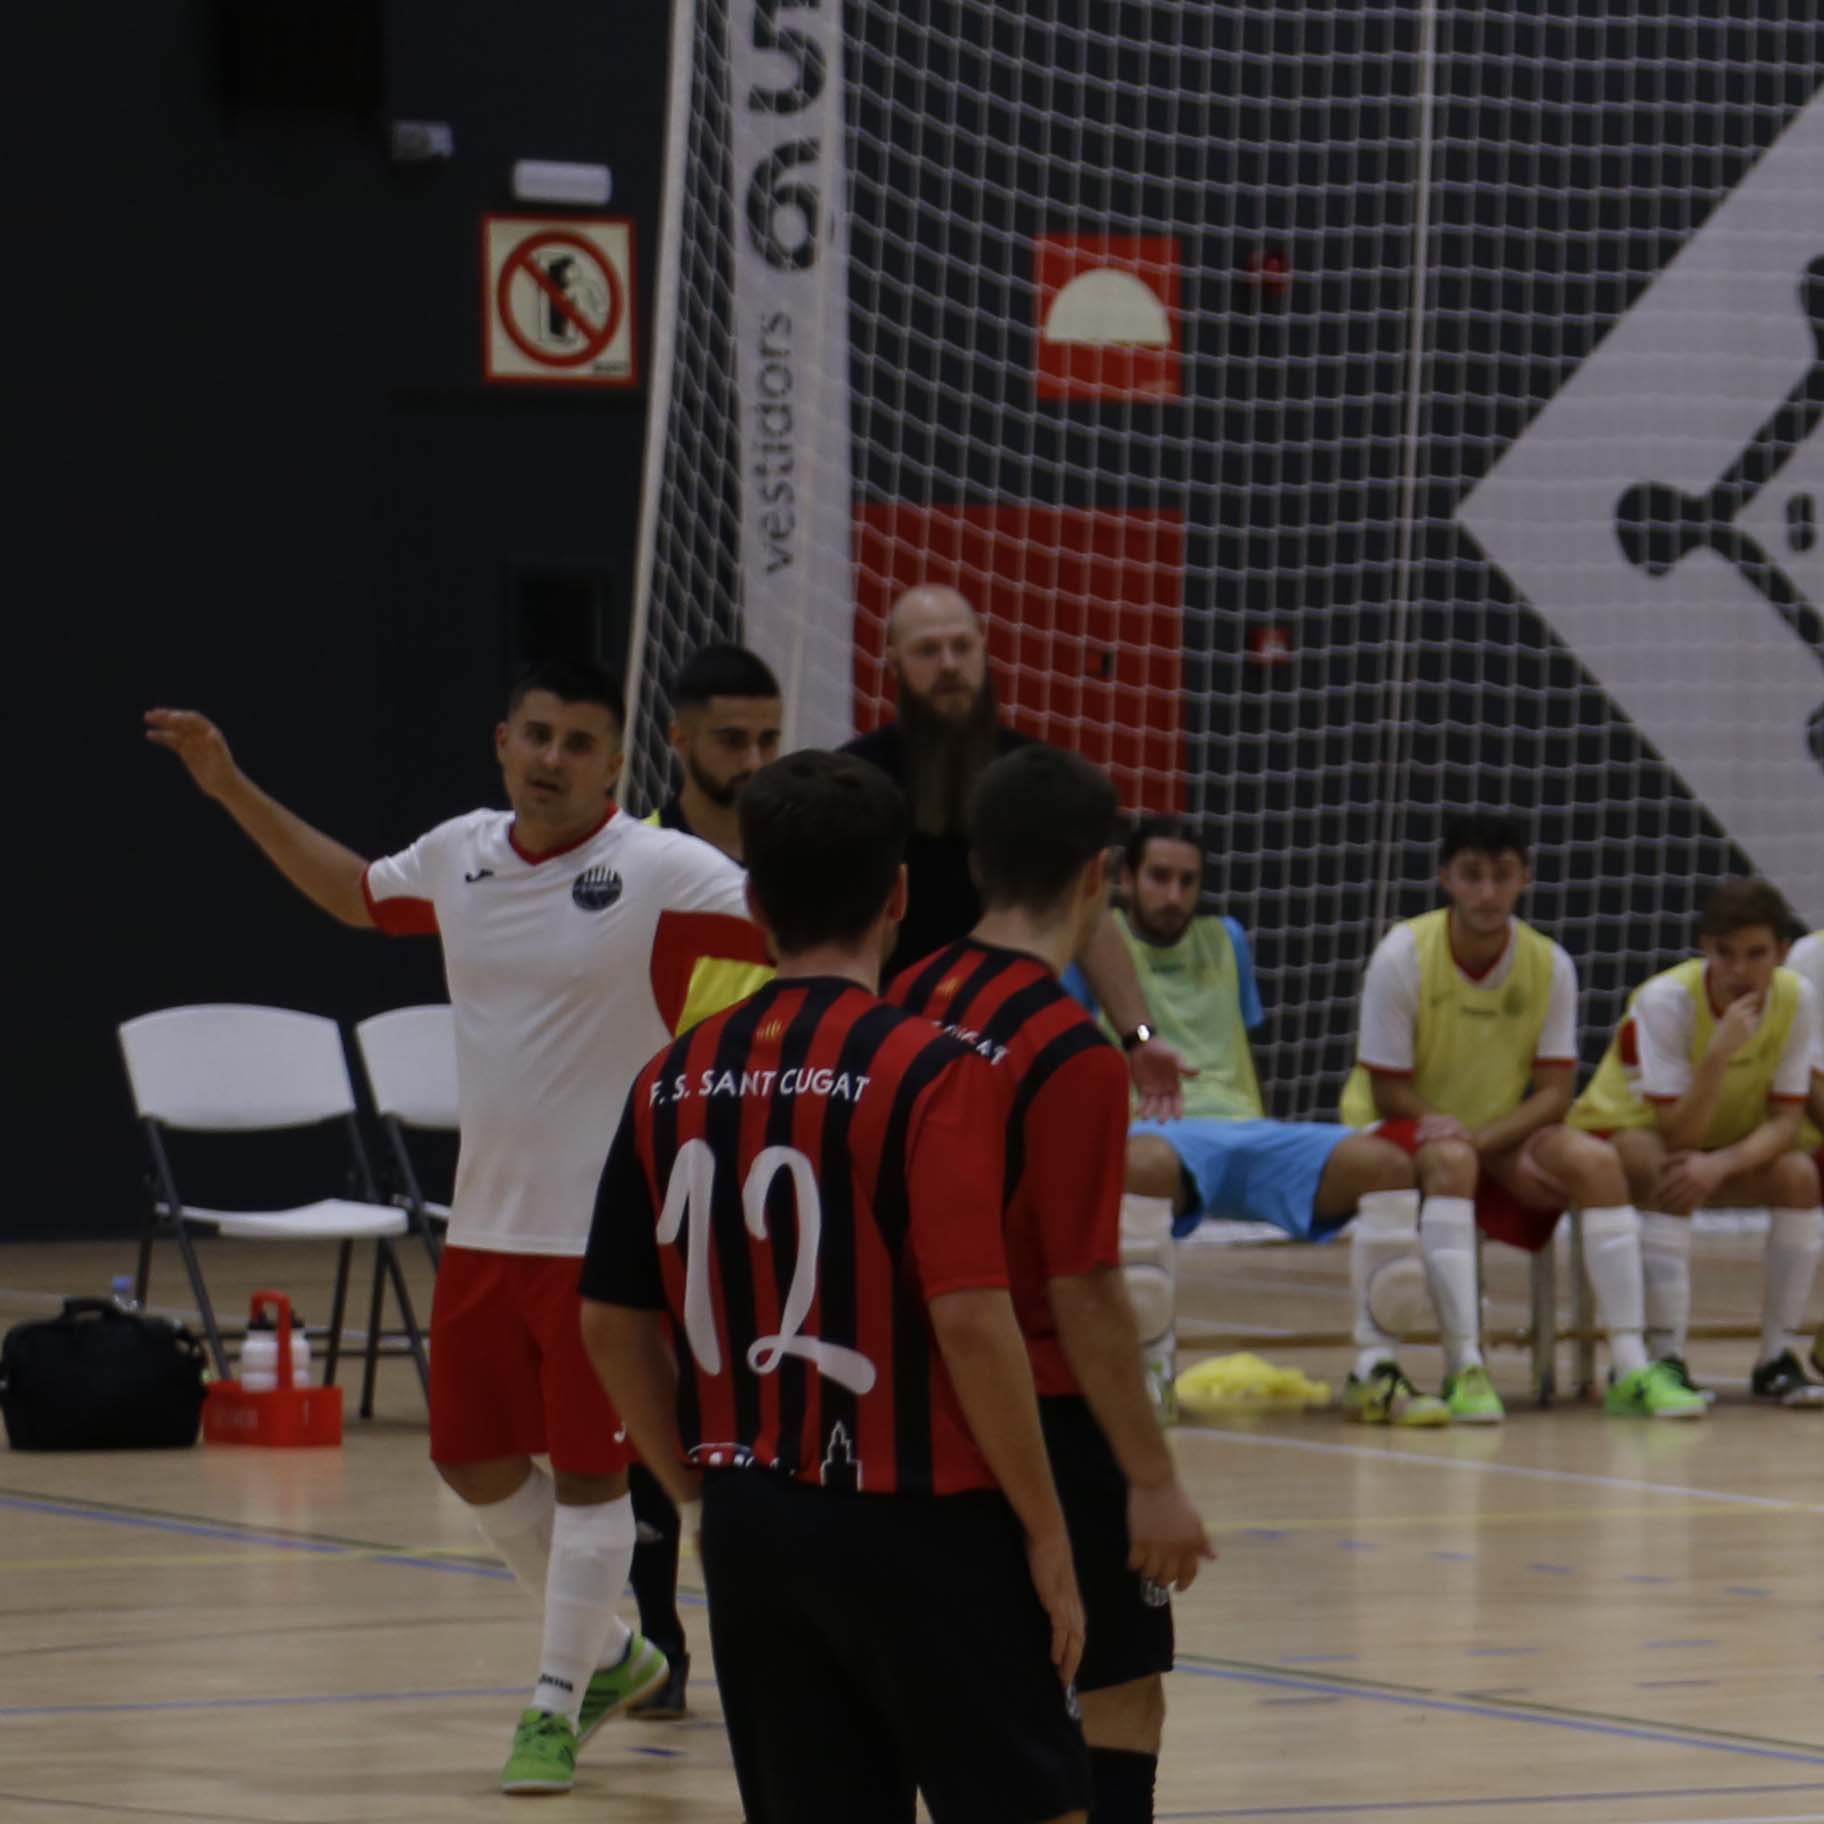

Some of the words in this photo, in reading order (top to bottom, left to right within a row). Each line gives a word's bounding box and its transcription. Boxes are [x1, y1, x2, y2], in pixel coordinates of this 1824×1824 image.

[748, 0, 827, 116] 5
[745, 137, 821, 271] 6
[754, 310, 796, 575] vestidors
[673, 1075, 691, 1100] S.
[698, 1067, 776, 1097] SANT
[780, 1067, 871, 1102] CUGAT
[656, 1137, 876, 1395] 12
